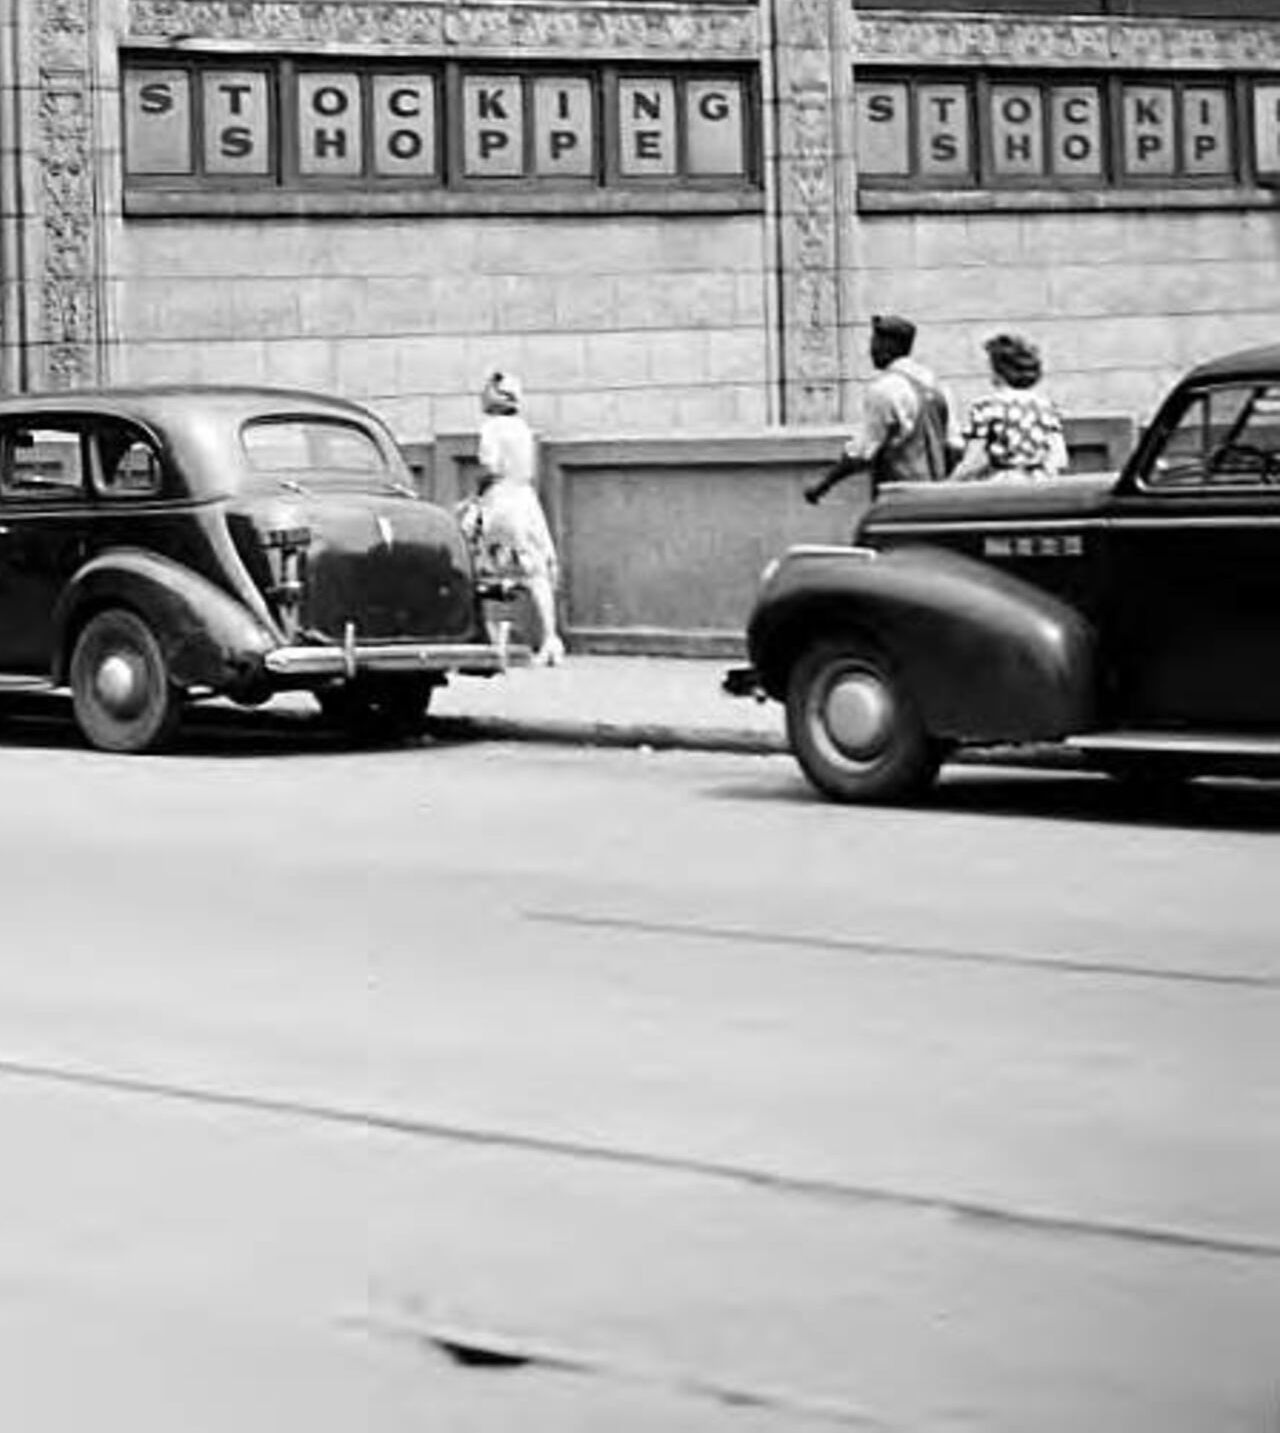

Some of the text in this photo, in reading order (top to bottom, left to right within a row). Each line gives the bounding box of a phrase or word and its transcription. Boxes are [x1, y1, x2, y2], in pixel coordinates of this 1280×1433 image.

[139, 83, 730, 121] STOCKING
[868, 95, 1280, 125] STOCKI
[221, 126, 662, 160] SHOPPE
[931, 134, 1280, 162] SHOPP
